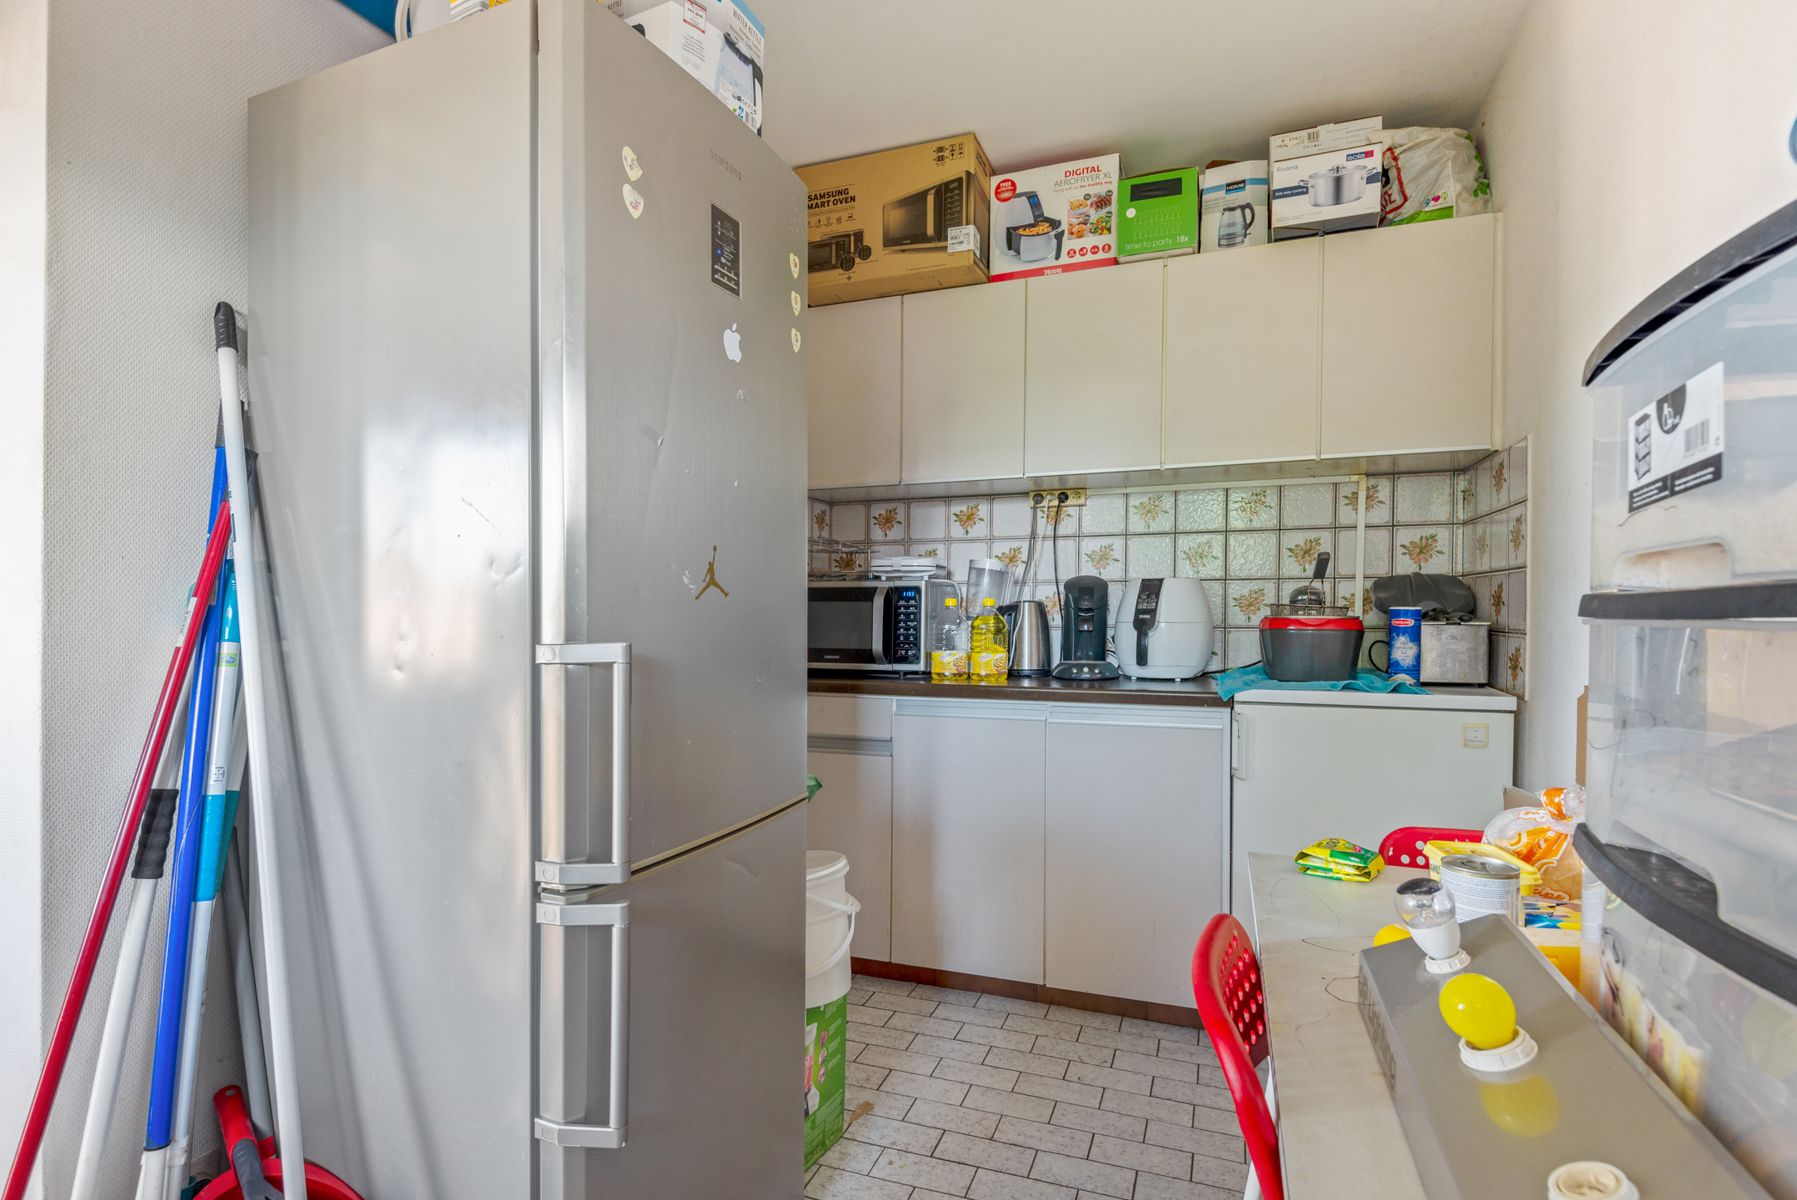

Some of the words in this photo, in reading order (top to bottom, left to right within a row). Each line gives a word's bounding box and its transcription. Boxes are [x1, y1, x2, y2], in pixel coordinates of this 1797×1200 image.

[1064, 165, 1102, 178] DIGITAL
[1053, 173, 1101, 188] AEROFRYER
[1102, 171, 1112, 179] XL
[808, 187, 849, 203] SAMSUNG
[808, 199, 831, 210] MART
[832, 195, 856, 206] OVEN
[1152, 239, 1172, 248] party
